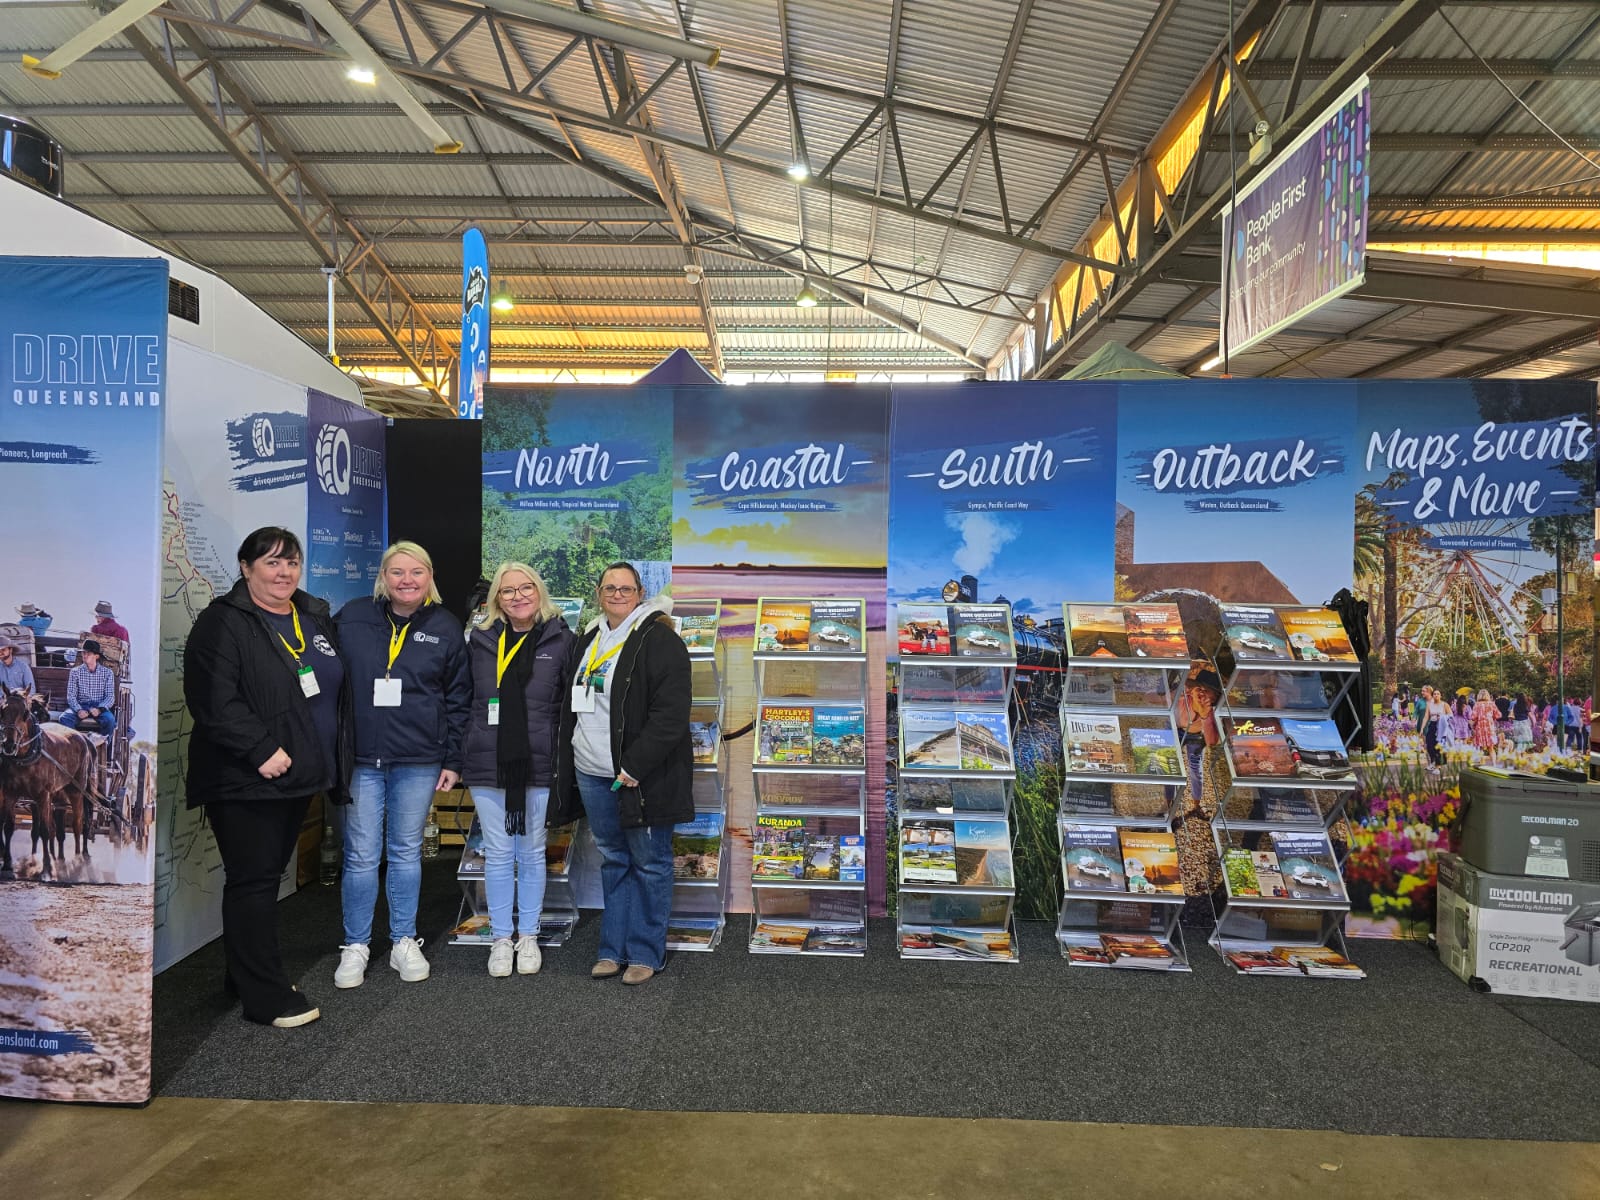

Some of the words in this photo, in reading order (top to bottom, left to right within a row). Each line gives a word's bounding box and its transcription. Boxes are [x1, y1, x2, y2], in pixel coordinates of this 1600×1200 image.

[1246, 199, 1281, 242] People
[1281, 176, 1307, 215] First
[1246, 234, 1272, 269] Bank
[1269, 241, 1307, 275] community
[12, 333, 160, 386] DRIVE
[13, 389, 161, 406] QUEENSLAND
[274, 425, 300, 443] DRIVE
[1472, 416, 1597, 463] Events
[31, 448, 68, 461] Longreach
[352, 444, 382, 479] DRIVE
[514, 442, 615, 489] North
[719, 442, 850, 491] Coastal
[937, 440, 1059, 490] South
[1152, 439, 1323, 491] Outback
[252, 470, 306, 487] drivequeensland.com
[1413, 476, 1443, 520] &
[1448, 472, 1546, 519] More
[561, 501, 579, 509] Tropical
[738, 502, 750, 510] Cape
[810, 502, 826, 511] Region
[988, 501, 1004, 510] Pacific
[1018, 502, 1029, 511] Way
[1219, 501, 1240, 509] Outback
[1240, 501, 1269, 510] Queensland
[1469, 539, 1491, 547] Carnival
[1497, 540, 1517, 549] Flowers
[765, 708, 811, 716] HARTLEY'S
[1253, 724, 1276, 732] Great
[758, 816, 803, 827] KURANDA
[1567, 817, 1580, 827] 20
[1498, 901, 1525, 910] Powered
[1525, 903, 1532, 911] by
[1532, 903, 1564, 912] Adventure
[1489, 941, 1531, 953] CCP20R
[1488, 959, 1583, 977] RECREATIONAL
